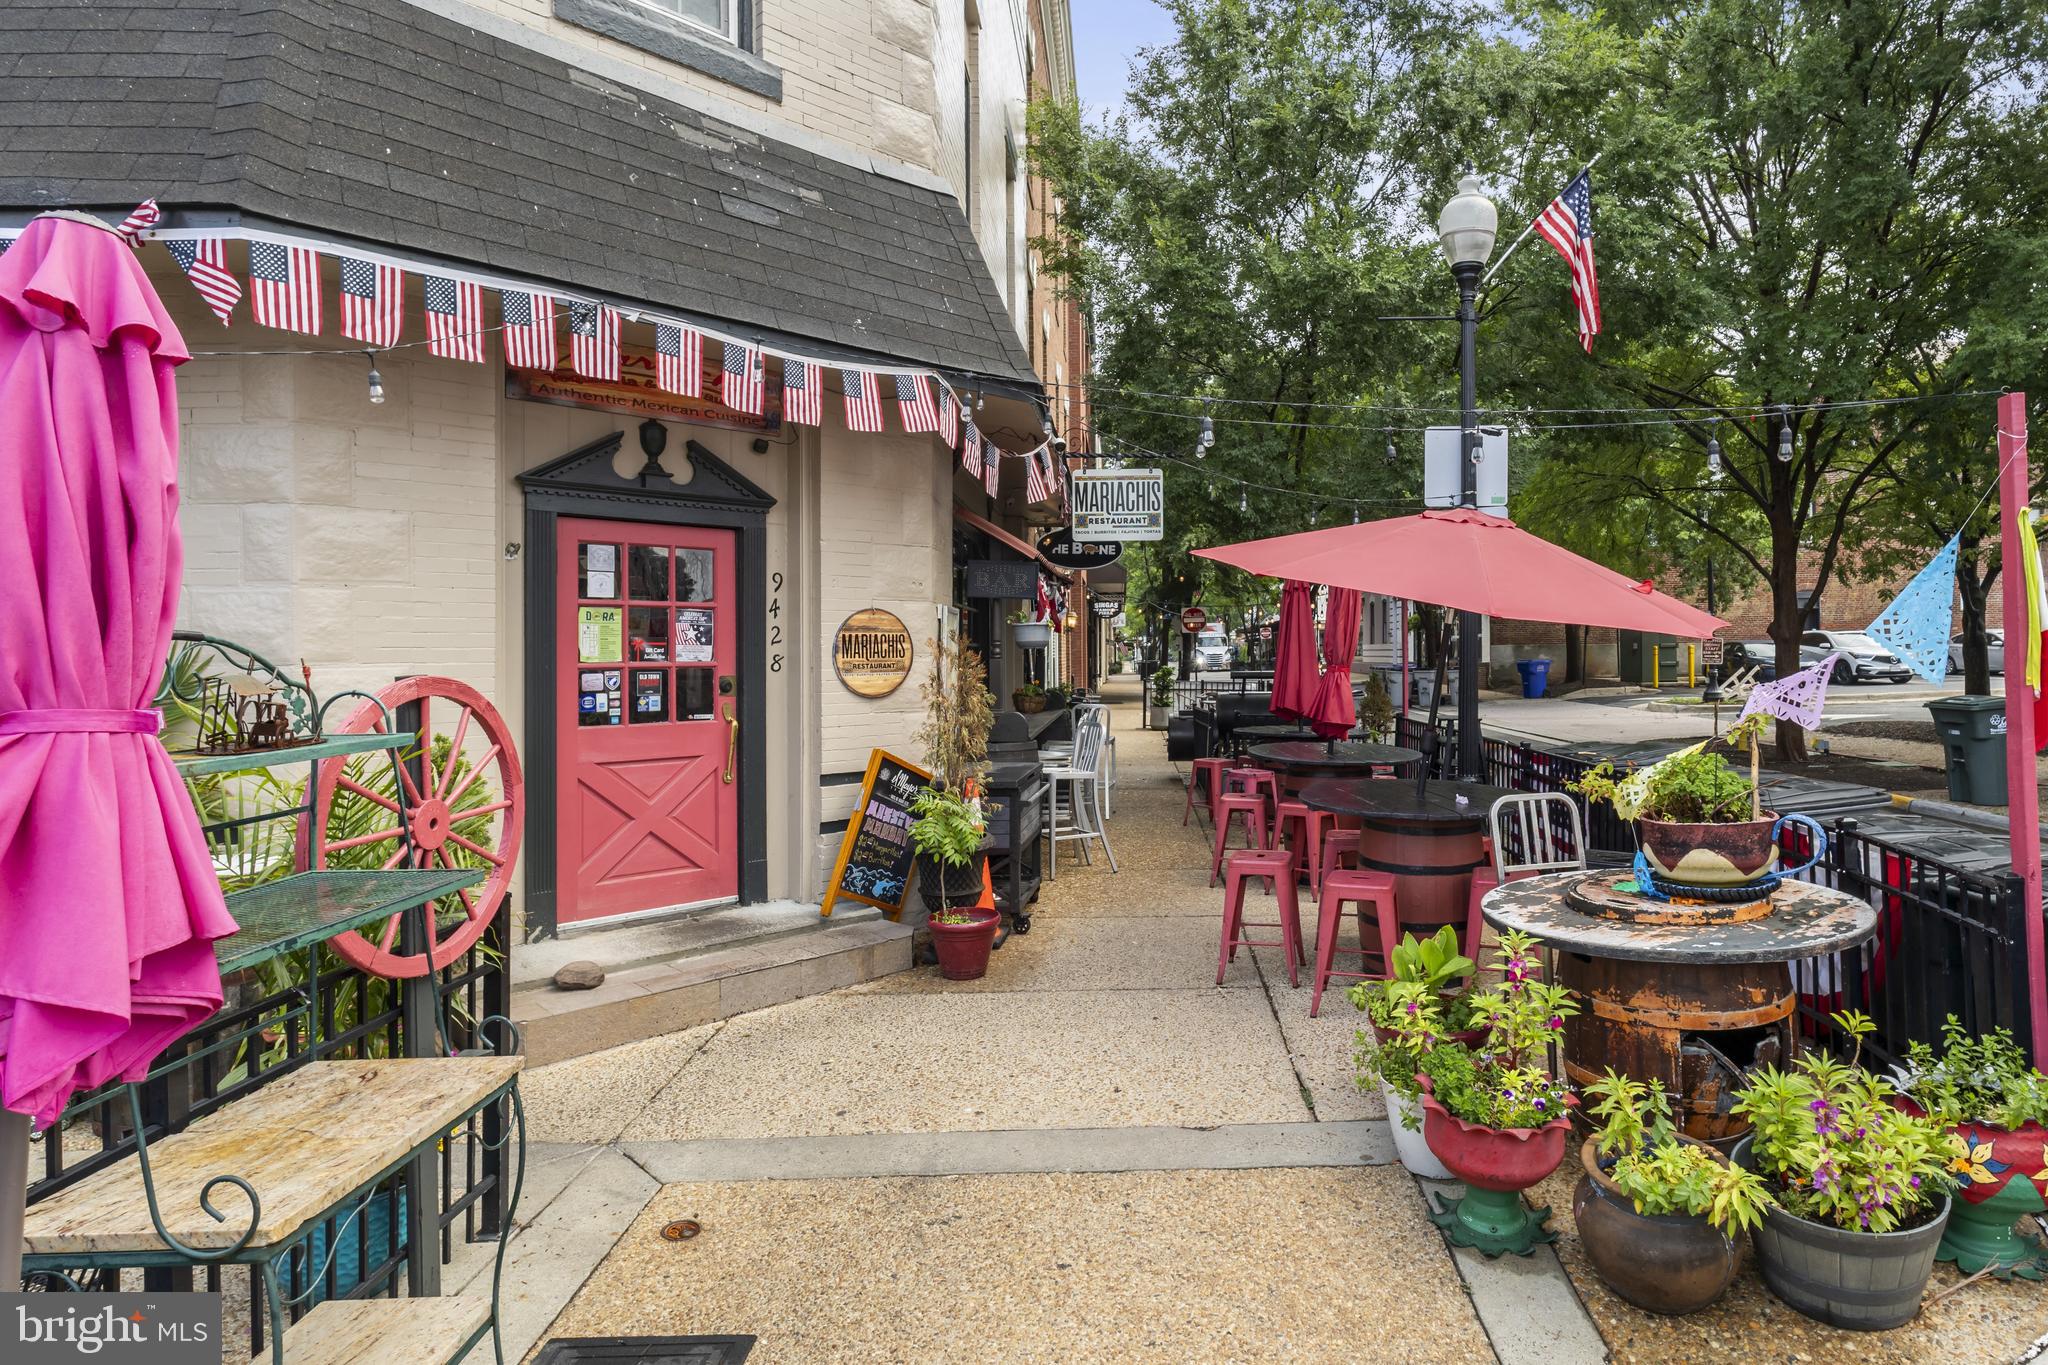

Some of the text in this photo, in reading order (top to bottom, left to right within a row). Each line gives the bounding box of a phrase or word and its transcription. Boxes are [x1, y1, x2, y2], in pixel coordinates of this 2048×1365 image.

[538, 383, 627, 406] Authentic
[632, 398, 699, 417] Mexican
[704, 409, 761, 426] Cuisine
[1074, 481, 1160, 515] MARIACHIS
[1088, 517, 1147, 525] RESTAURANT
[1052, 544, 1069, 554] HE
[975, 572, 1029, 590] BAR
[842, 633, 906, 661] MARIACHIS
